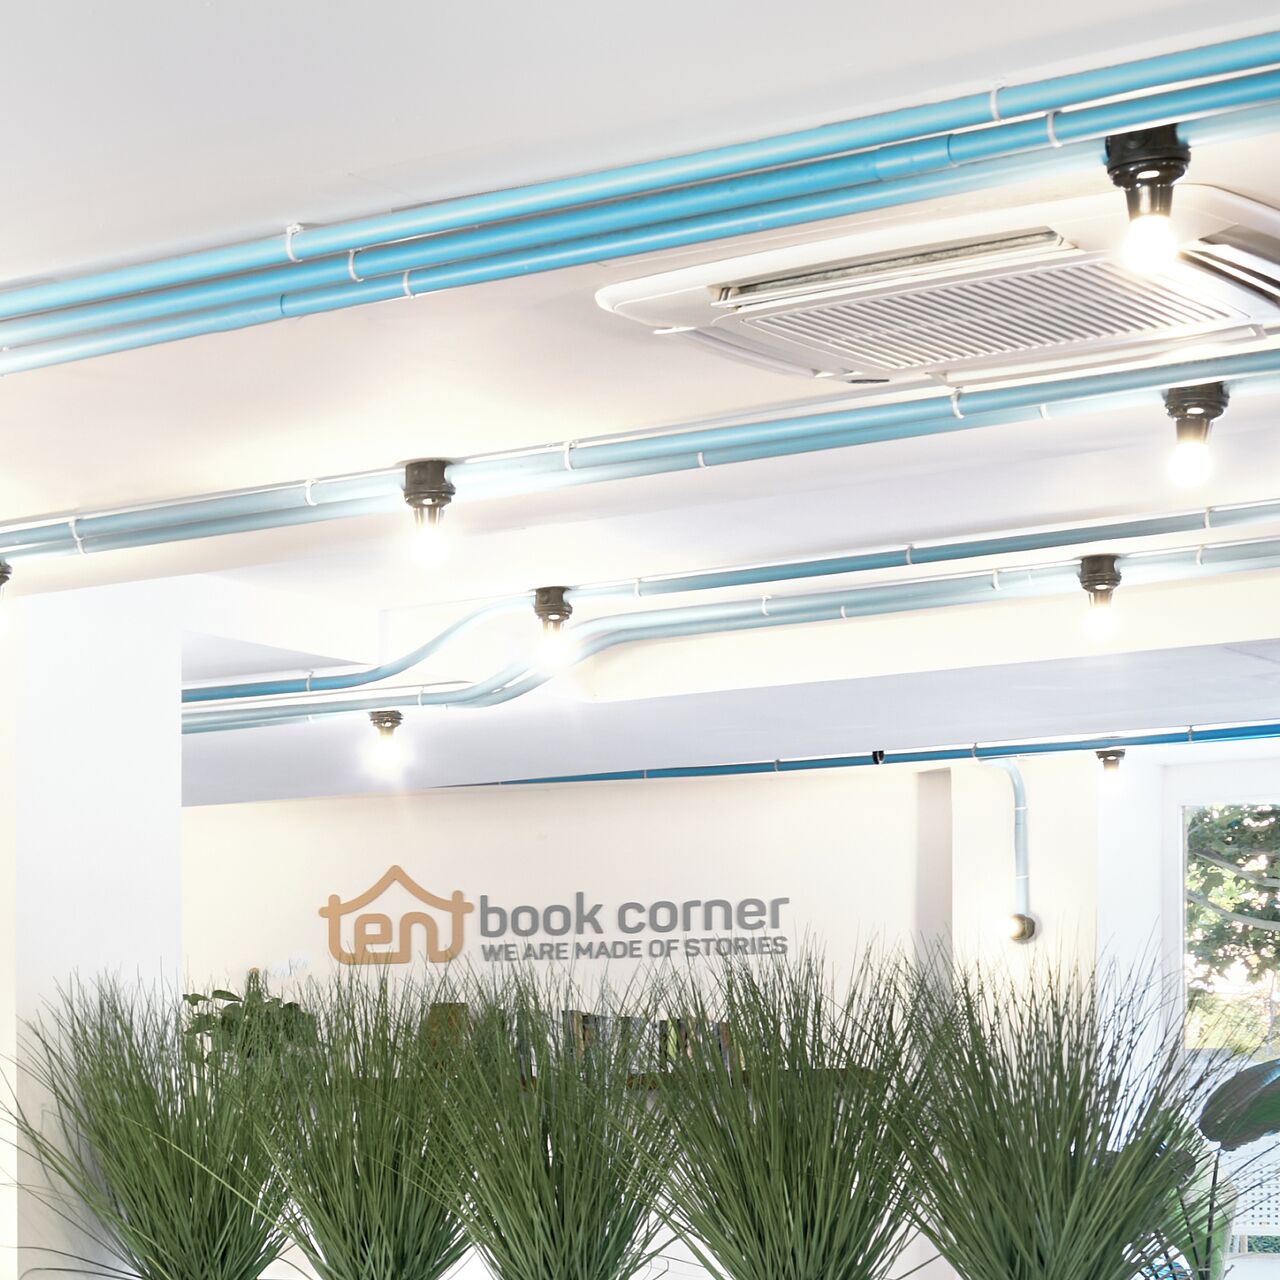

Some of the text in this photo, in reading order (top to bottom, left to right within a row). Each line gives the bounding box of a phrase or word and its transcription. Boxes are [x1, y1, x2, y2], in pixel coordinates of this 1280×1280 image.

[479, 891, 604, 938] book
[618, 897, 790, 934] corner
[482, 936, 790, 962] WE ARE MADE OF STORIES
